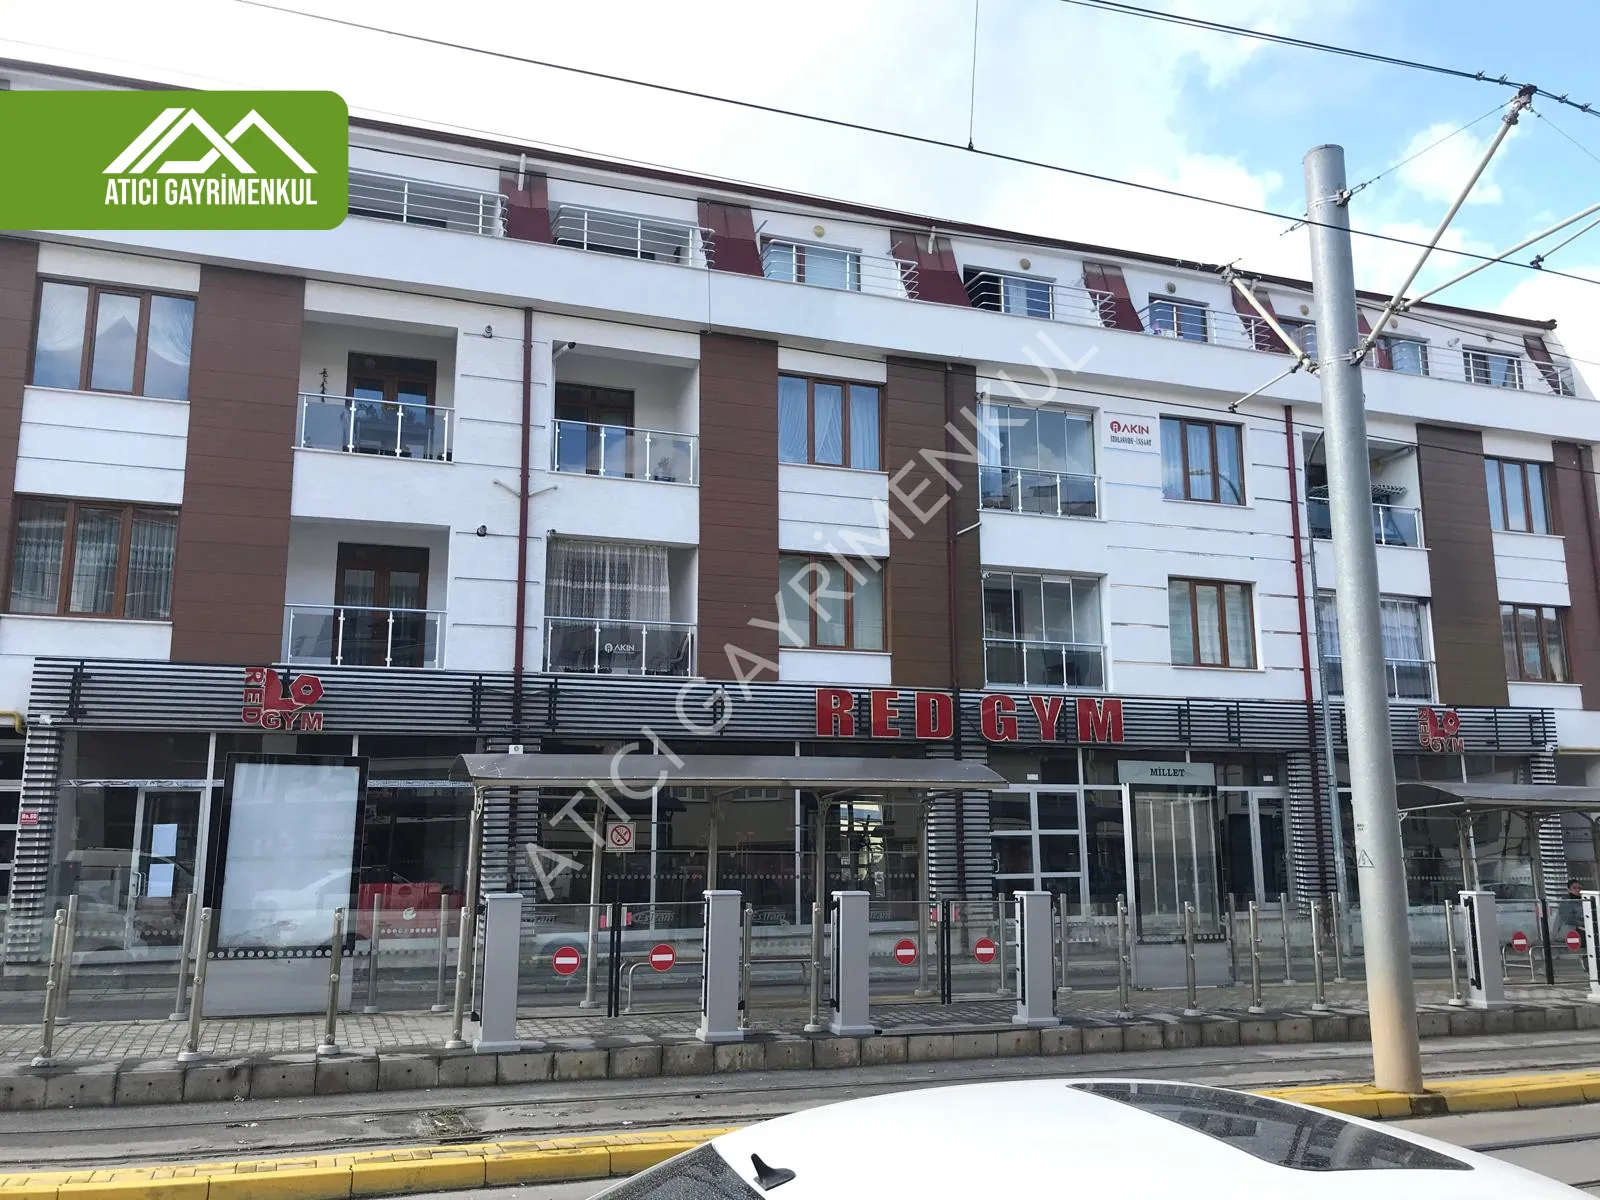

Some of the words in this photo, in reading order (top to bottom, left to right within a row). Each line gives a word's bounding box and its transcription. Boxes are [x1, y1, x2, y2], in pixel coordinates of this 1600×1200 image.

[1121, 424, 1149, 434] AKIN
[614, 643, 635, 651] AKIN
[242, 667, 266, 725] RED
[260, 709, 324, 731] GYM
[815, 687, 954, 739] RED
[979, 693, 1125, 743] GYM
[1430, 737, 1465, 752] GYM
[1149, 766, 1187, 777] MİLLET
